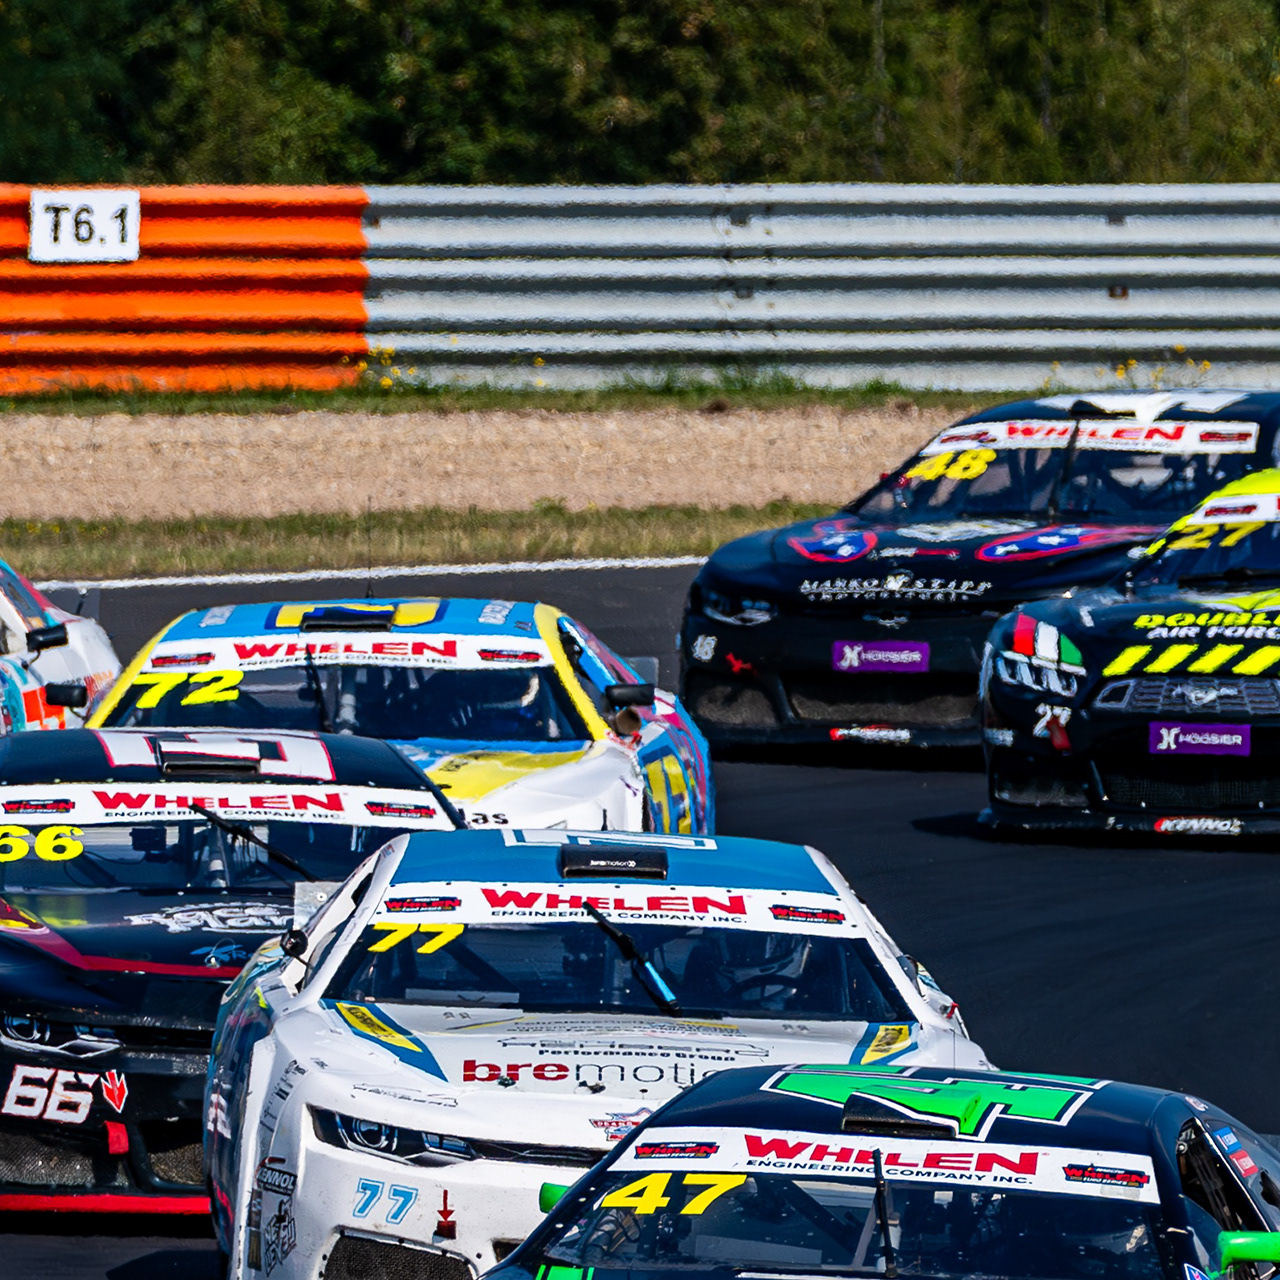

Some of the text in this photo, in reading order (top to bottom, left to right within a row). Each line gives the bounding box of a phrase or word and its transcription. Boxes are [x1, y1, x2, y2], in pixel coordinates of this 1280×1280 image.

[44, 204, 128, 243] T6.1
[1167, 520, 1266, 550] 27
[1147, 626, 1201, 640] AIR
[233, 640, 458, 660] WHELEN
[132, 670, 244, 709] 72
[93, 790, 345, 812] WHELEN
[480, 888, 747, 914] WHELEN
[617, 912, 707, 921] COMPANY
[367, 922, 465, 954] 77
[1, 1064, 100, 1124] 66
[744, 1134, 1039, 1176] WHELEN
[881, 1167, 986, 1181] COMPANY
[993, 1175, 1033, 1185] INC.
[352, 1177, 418, 1225] 77
[601, 1172, 747, 1215] 47
